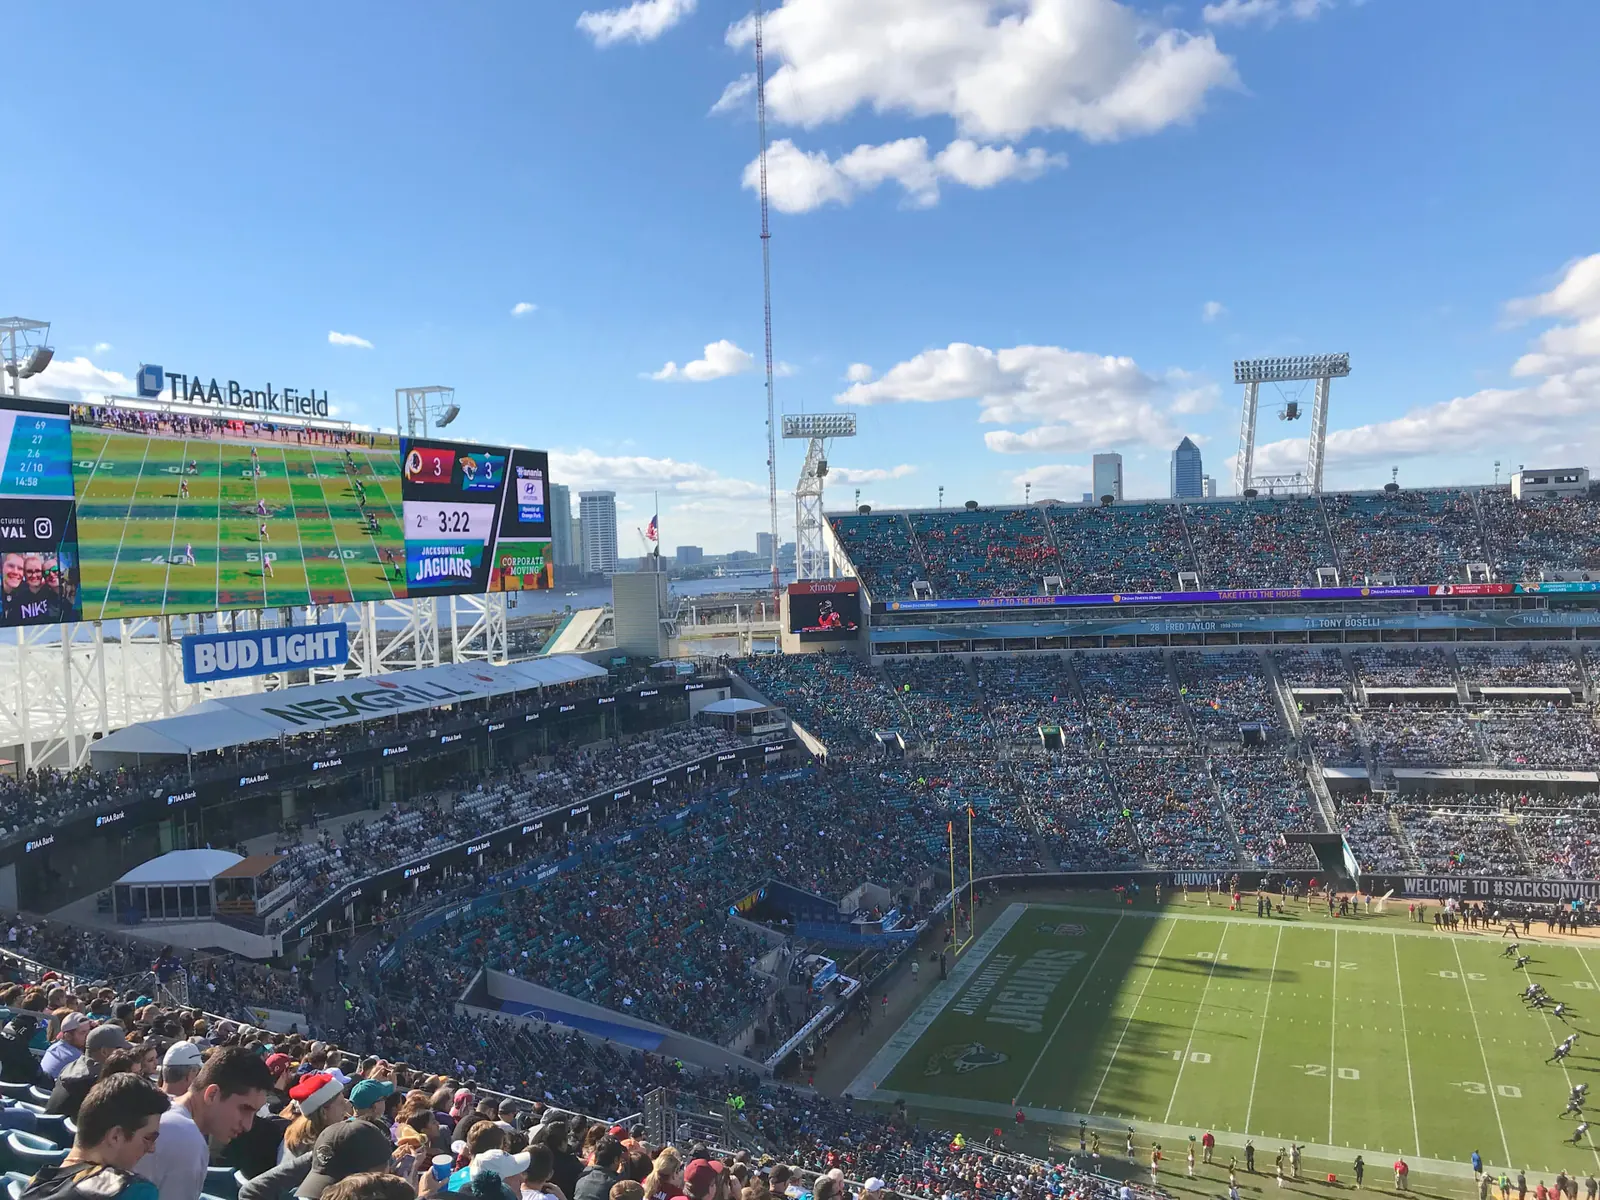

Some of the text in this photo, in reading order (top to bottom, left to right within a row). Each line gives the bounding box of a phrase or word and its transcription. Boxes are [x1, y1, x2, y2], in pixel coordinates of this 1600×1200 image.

[165, 372, 328, 417] TIAA Bank Field
[35, 421, 46, 430] 69
[32, 434, 42, 444] 27
[27, 449, 40, 458] 2.6
[20, 463, 43, 472] 2/10
[433, 457, 441, 476] 3
[485, 462, 492, 479] 3
[15, 476, 38, 487] 14:58
[438, 510, 470, 533] 3:22
[421, 546, 465, 556] JACKSONVILLE
[501, 556, 544, 566] CORPORATE
[415, 557, 472, 581] JAGUARS
[509, 565, 540, 576] MOVING
[809, 583, 837, 592] xfinity
[20, 599, 48, 619] NIKE
[1150, 623, 1160, 631] 28
[1165, 623, 1185, 631] FRED
[1187, 622, 1216, 630] TAYLOR
[1305, 619, 1315, 627] 71
[1320, 619, 1342, 627] TONY
[1345, 618, 1380, 627] BOSELLI
[194, 631, 339, 674] BUD LIGHT
[261, 682, 476, 726] NEXGRILL
[318, 758, 342, 769] TIAA Bank
[245, 773, 269, 784] TIAA Bank
[173, 790, 196, 803] TIAA Bank
[102, 811, 125, 825] TIAA Bank
[31, 834, 54, 850] TIAA Bank
[409, 863, 430, 876] TIAA Bank
[1404, 878, 1600, 899] WELCOME TO #SACKSONVILL
[953, 954, 1017, 1015] JACKSONVILLE
[986, 949, 1087, 1033] JAGUARS
[1172, 1050, 1211, 1064] 10
[1304, 1063, 1360, 1080] 20
[1462, 1081, 1522, 1098] 30
